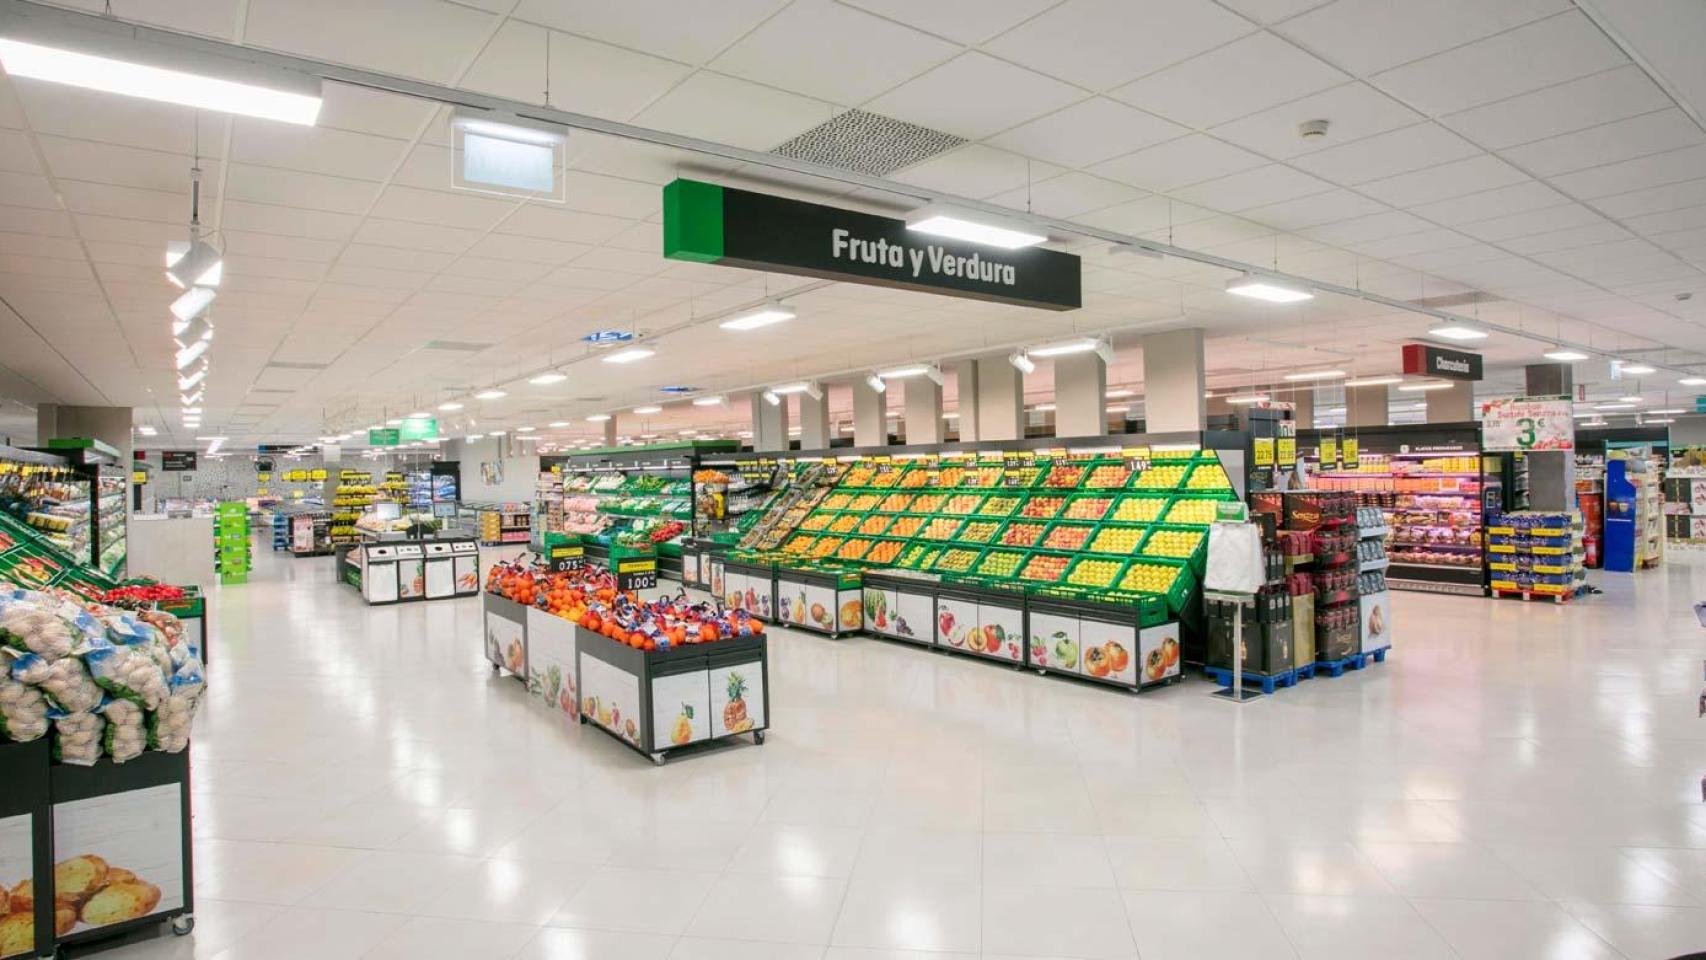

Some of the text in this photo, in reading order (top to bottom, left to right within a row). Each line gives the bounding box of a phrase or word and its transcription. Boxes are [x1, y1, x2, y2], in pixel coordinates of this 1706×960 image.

[832, 228, 1016, 286] Fruta y Verdura
[1516, 417, 1536, 446] 3
